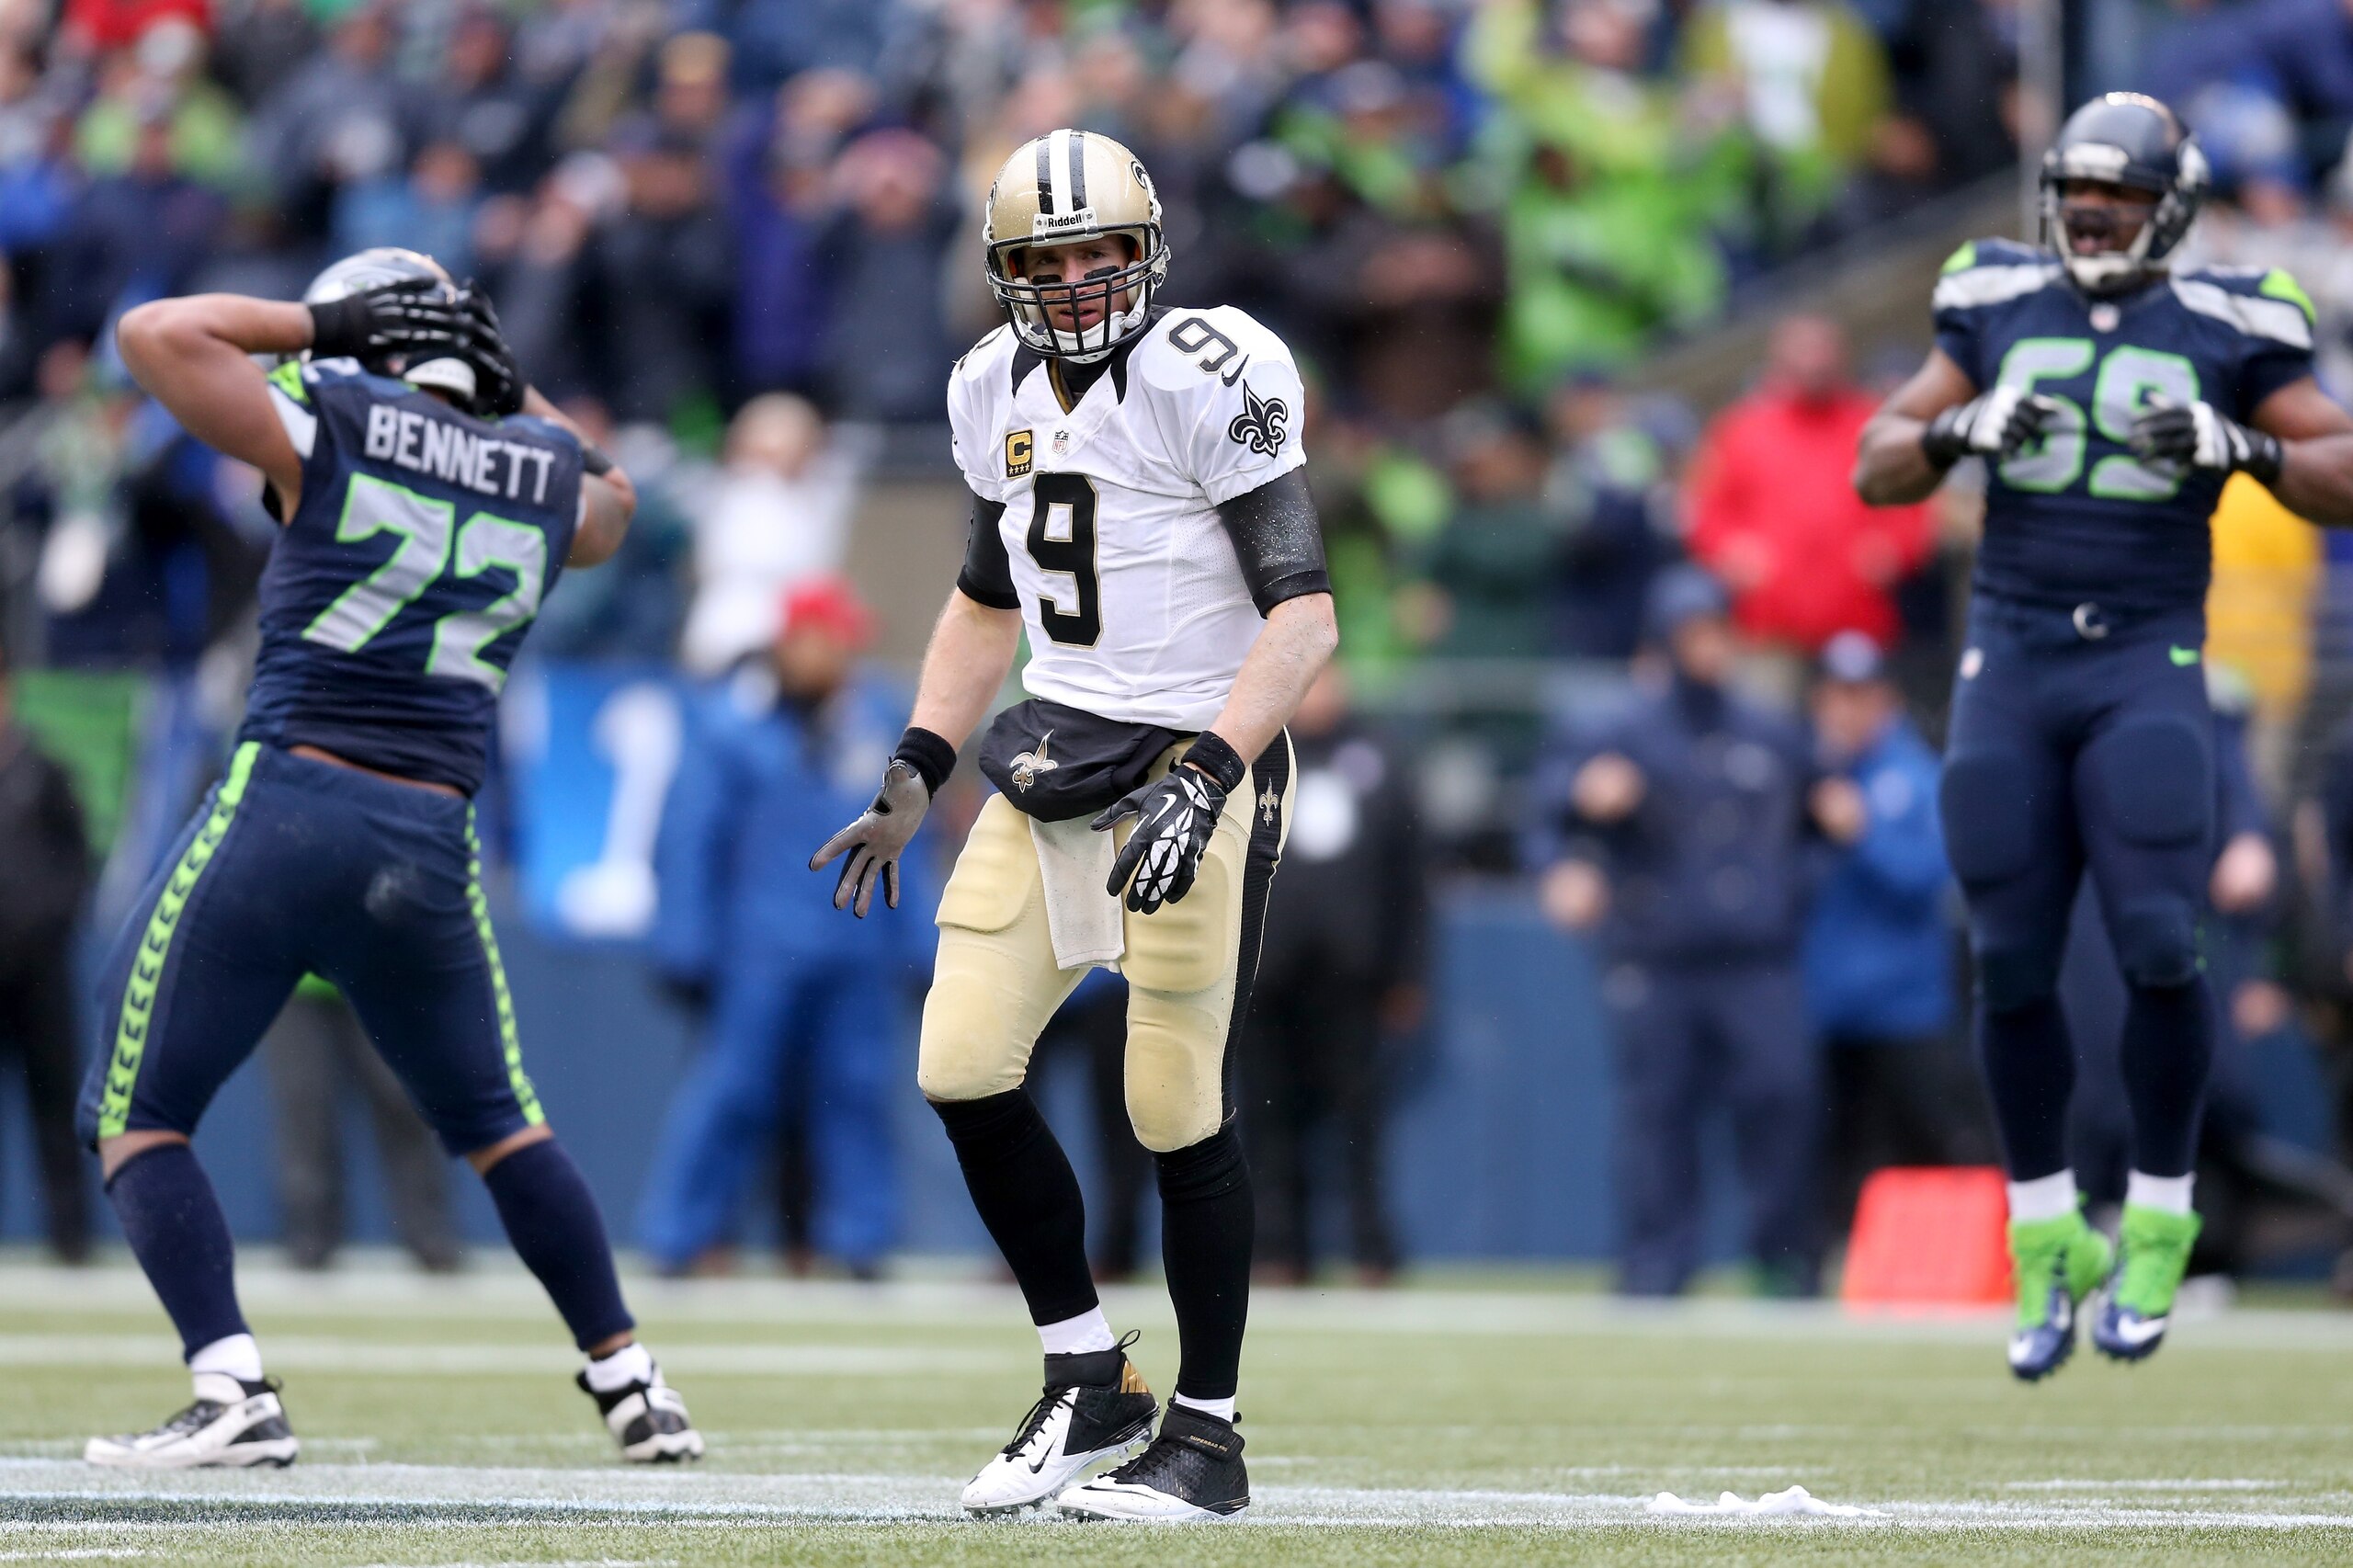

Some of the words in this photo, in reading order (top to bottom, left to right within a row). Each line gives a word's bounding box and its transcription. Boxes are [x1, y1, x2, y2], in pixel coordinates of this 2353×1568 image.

[1048, 213, 1082, 228] Riddell
[1167, 317, 1239, 373] 9
[365, 404, 555, 504] BENNETT
[1007, 432, 1031, 466] C
[301, 471, 547, 691] 72
[1025, 472, 1104, 651] 9
